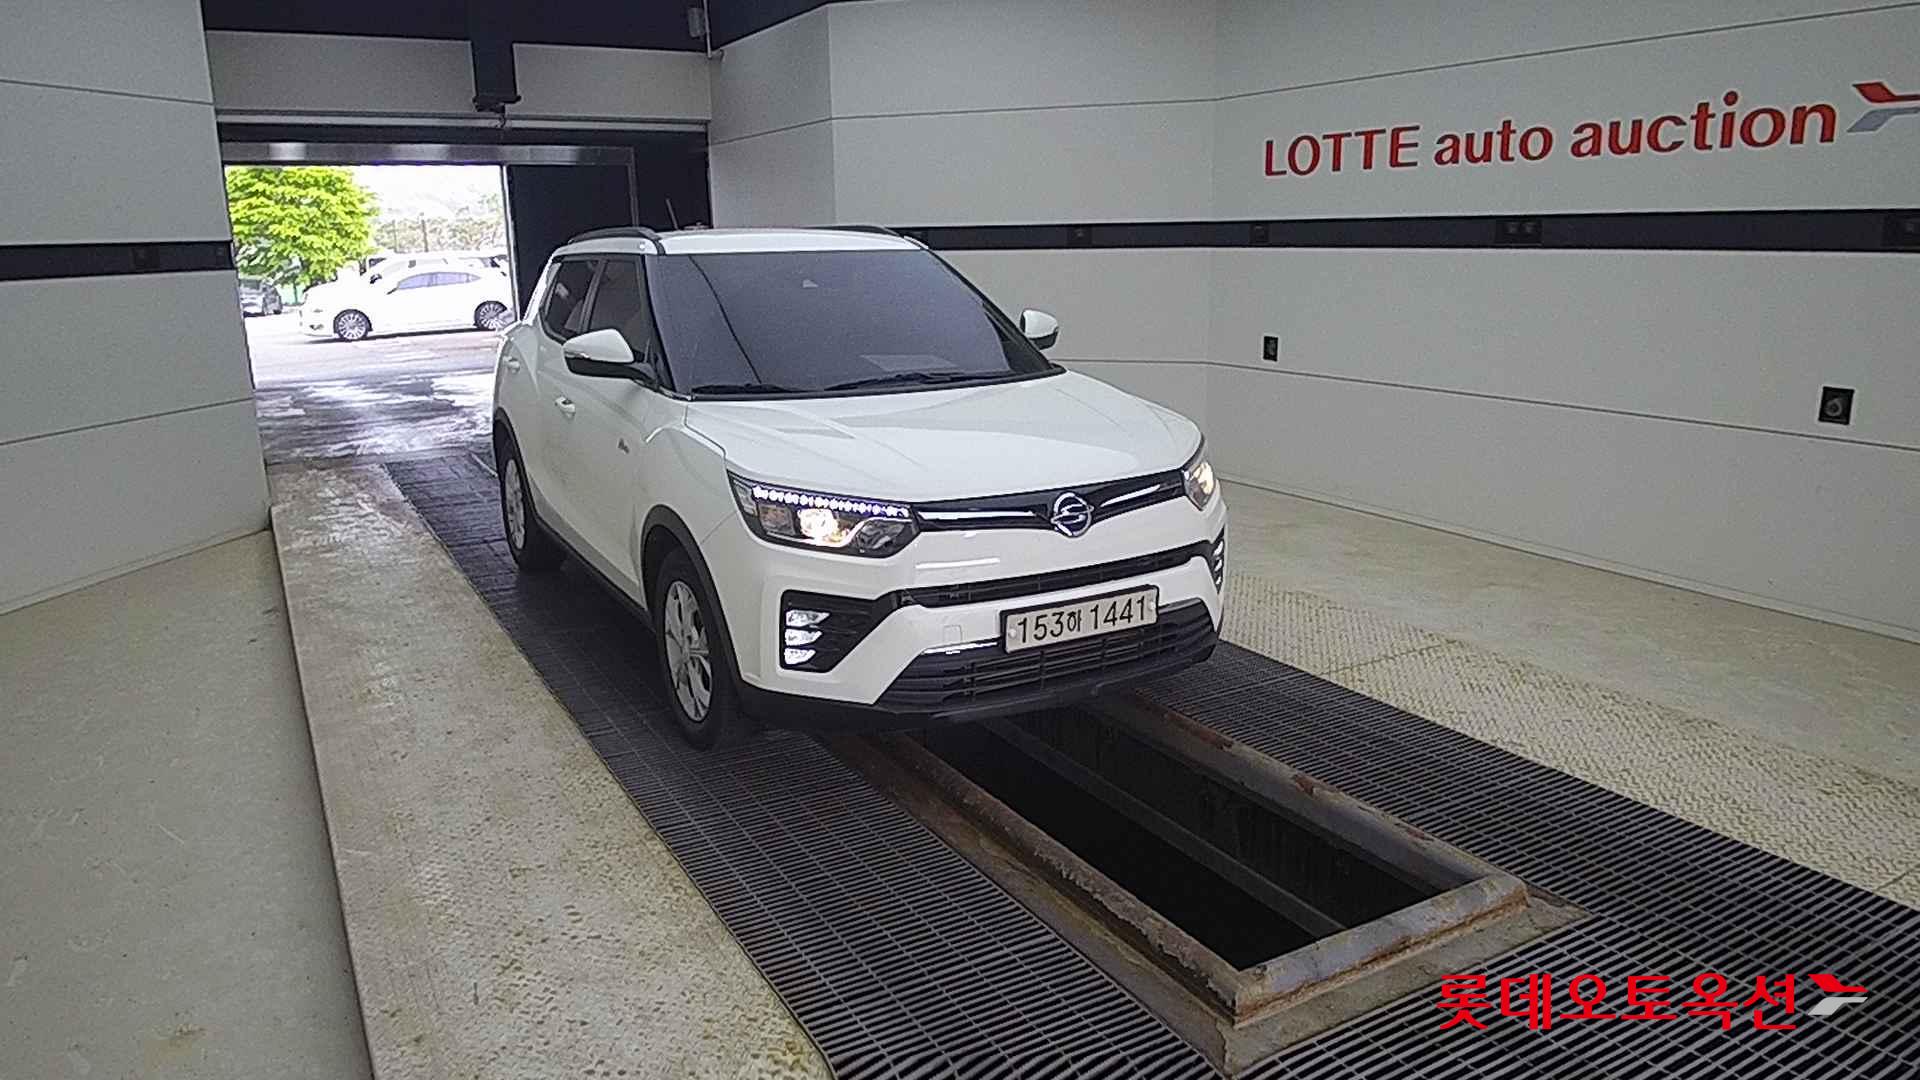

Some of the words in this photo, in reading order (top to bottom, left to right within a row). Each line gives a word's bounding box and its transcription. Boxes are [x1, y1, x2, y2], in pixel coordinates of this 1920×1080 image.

[1264, 125, 1420, 176] LOTTE
[1434, 120, 1553, 165] auto
[1571, 91, 1837, 158] auction
[1018, 609, 1082, 643] 153하
[1090, 596, 1145, 630] 1441
